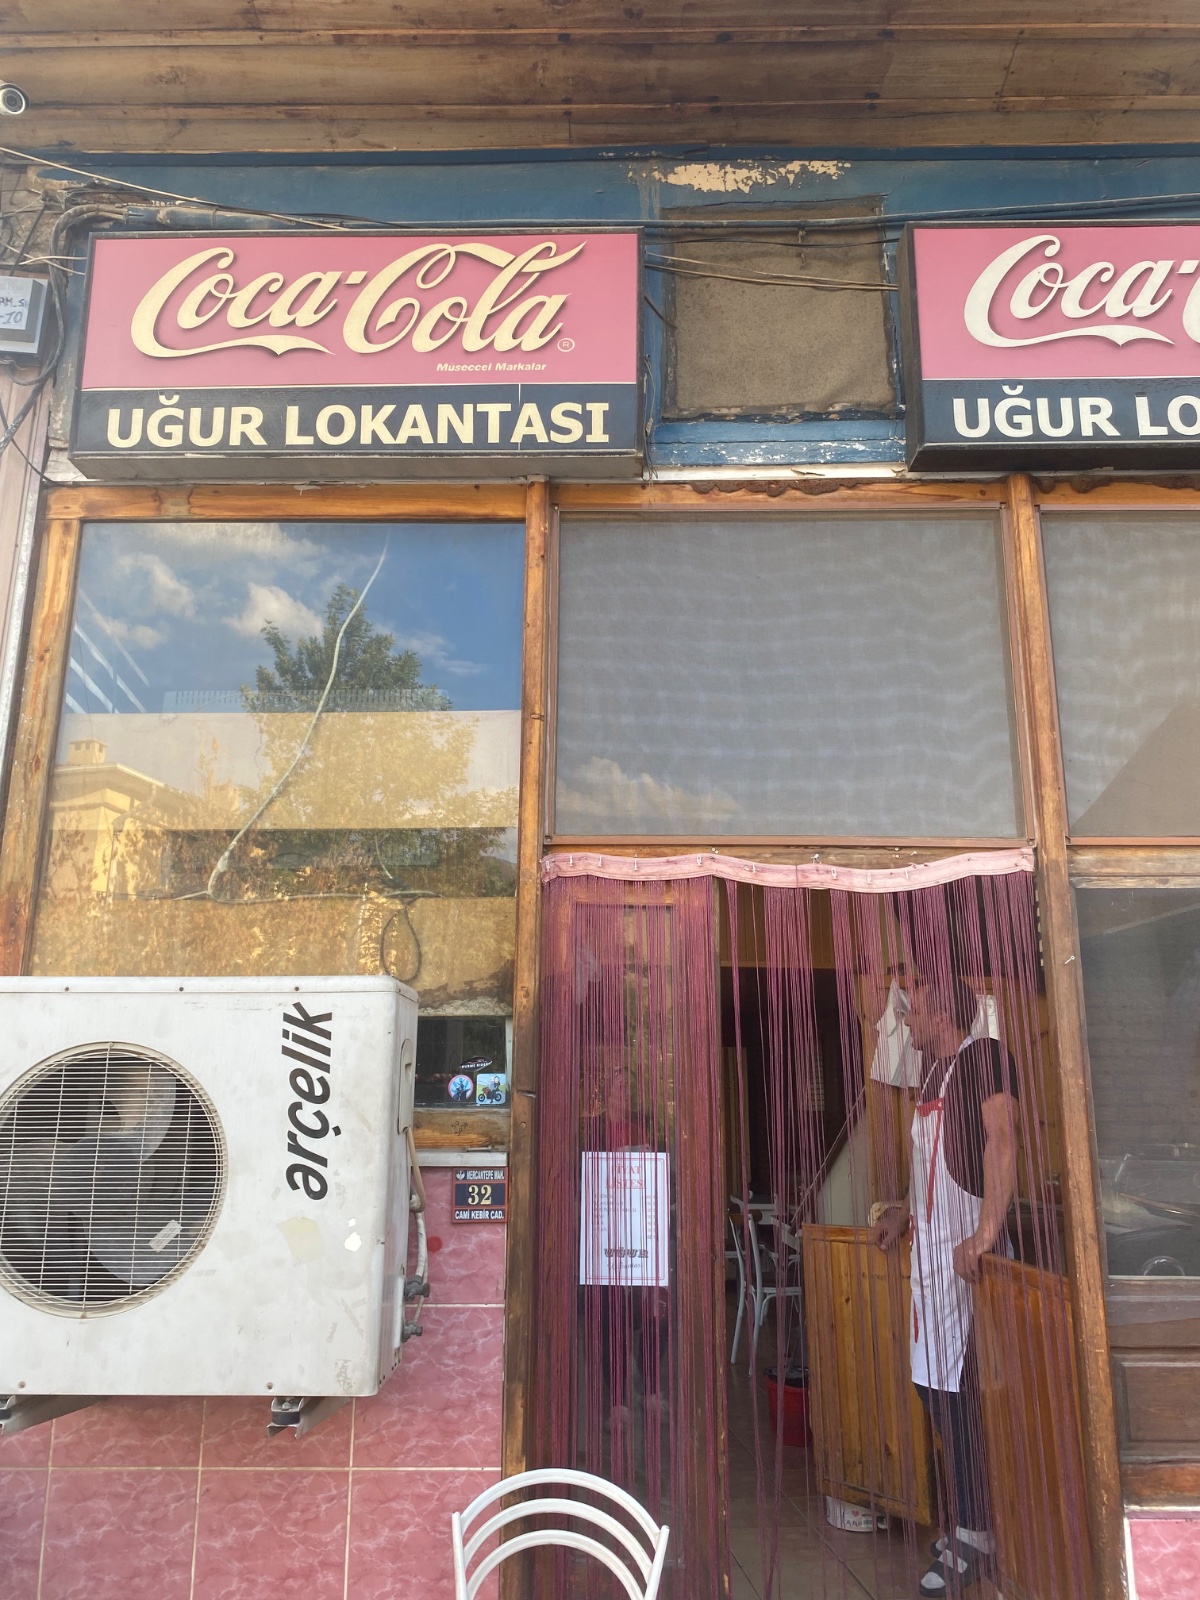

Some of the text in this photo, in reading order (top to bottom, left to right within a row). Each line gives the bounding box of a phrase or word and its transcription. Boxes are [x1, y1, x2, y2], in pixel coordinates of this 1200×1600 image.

[130, 241, 588, 357] Coca-Cola
[436, 362, 547, 372] Müseccel Markalar
[107, 393, 611, 448] UĞUR LOKANTASI
[952, 385, 1121, 438] UĞUR
[281, 1002, 341, 1201] arçelik
[455, 1209, 504, 1219] CAMİ KEBİR CAD.
[468, 1184, 492, 1205] 32
